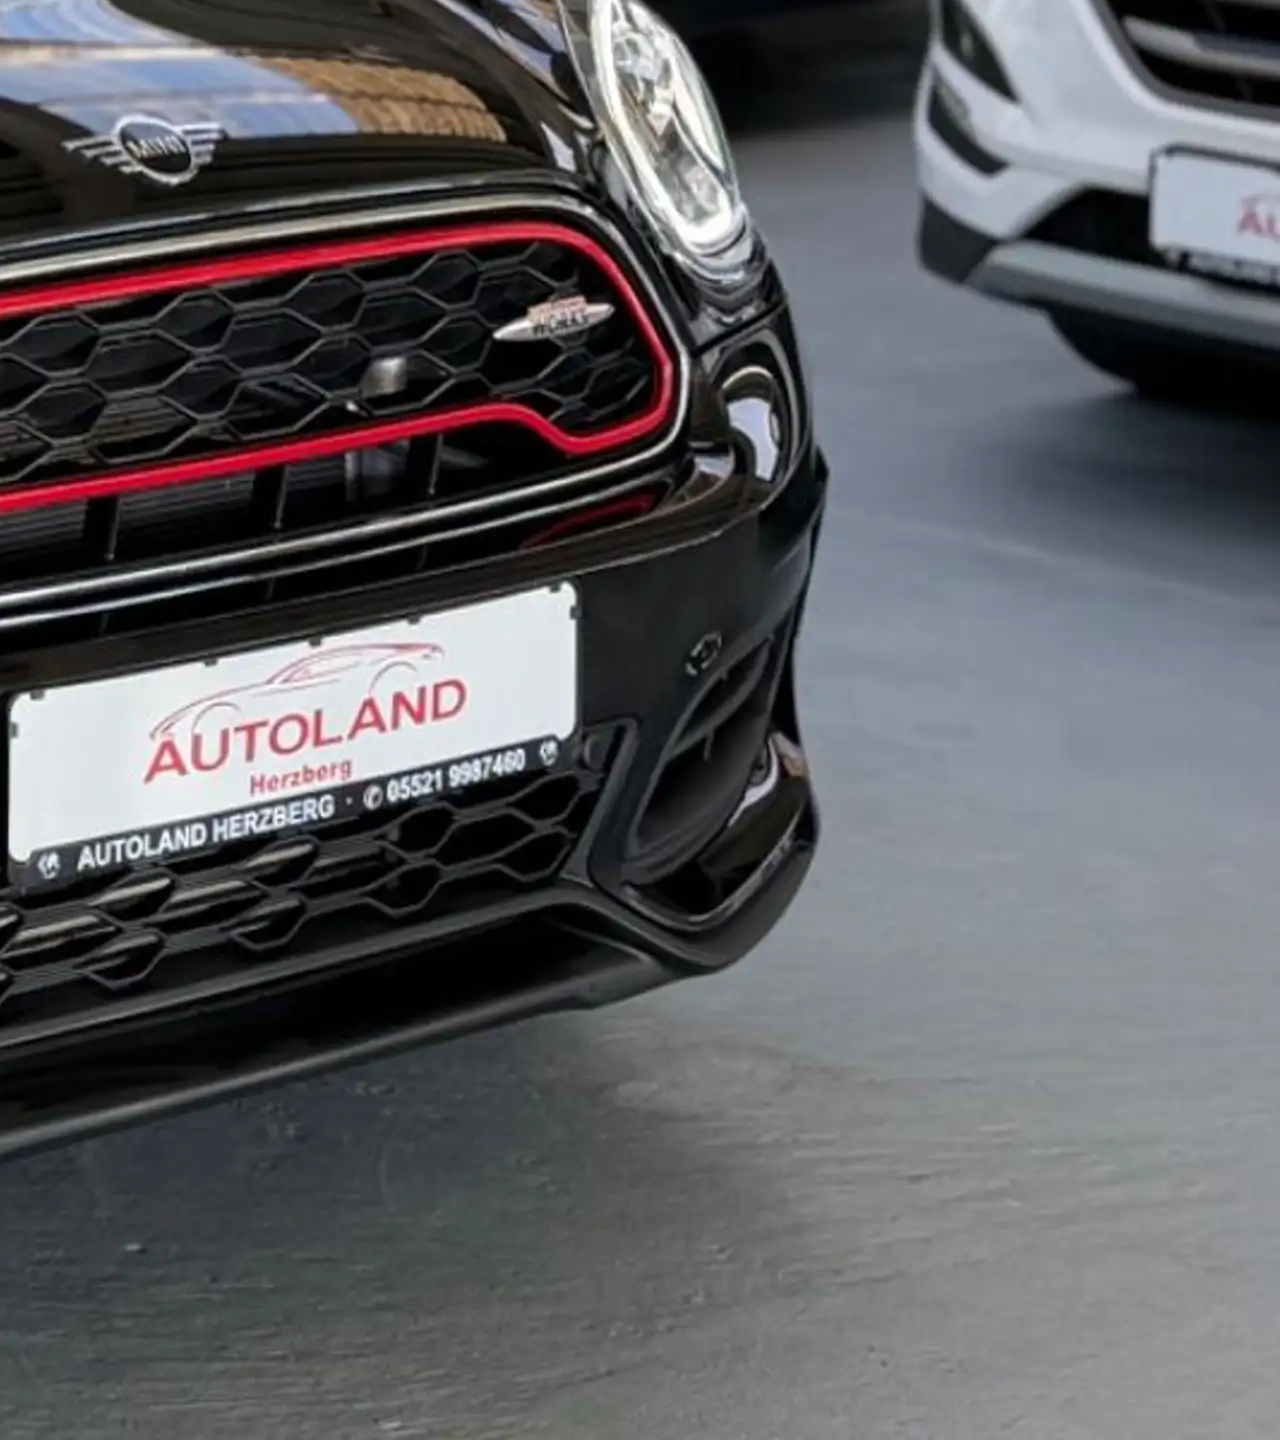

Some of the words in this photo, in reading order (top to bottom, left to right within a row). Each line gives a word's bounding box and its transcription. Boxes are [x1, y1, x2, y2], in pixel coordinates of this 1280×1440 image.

[143, 677, 468, 785] AUTOLAND
[249, 759, 354, 796] Herzberg
[76, 822, 208, 872] AUTOLAND
[212, 794, 337, 843] HERZBERG
[386, 769, 443, 803] 05521
